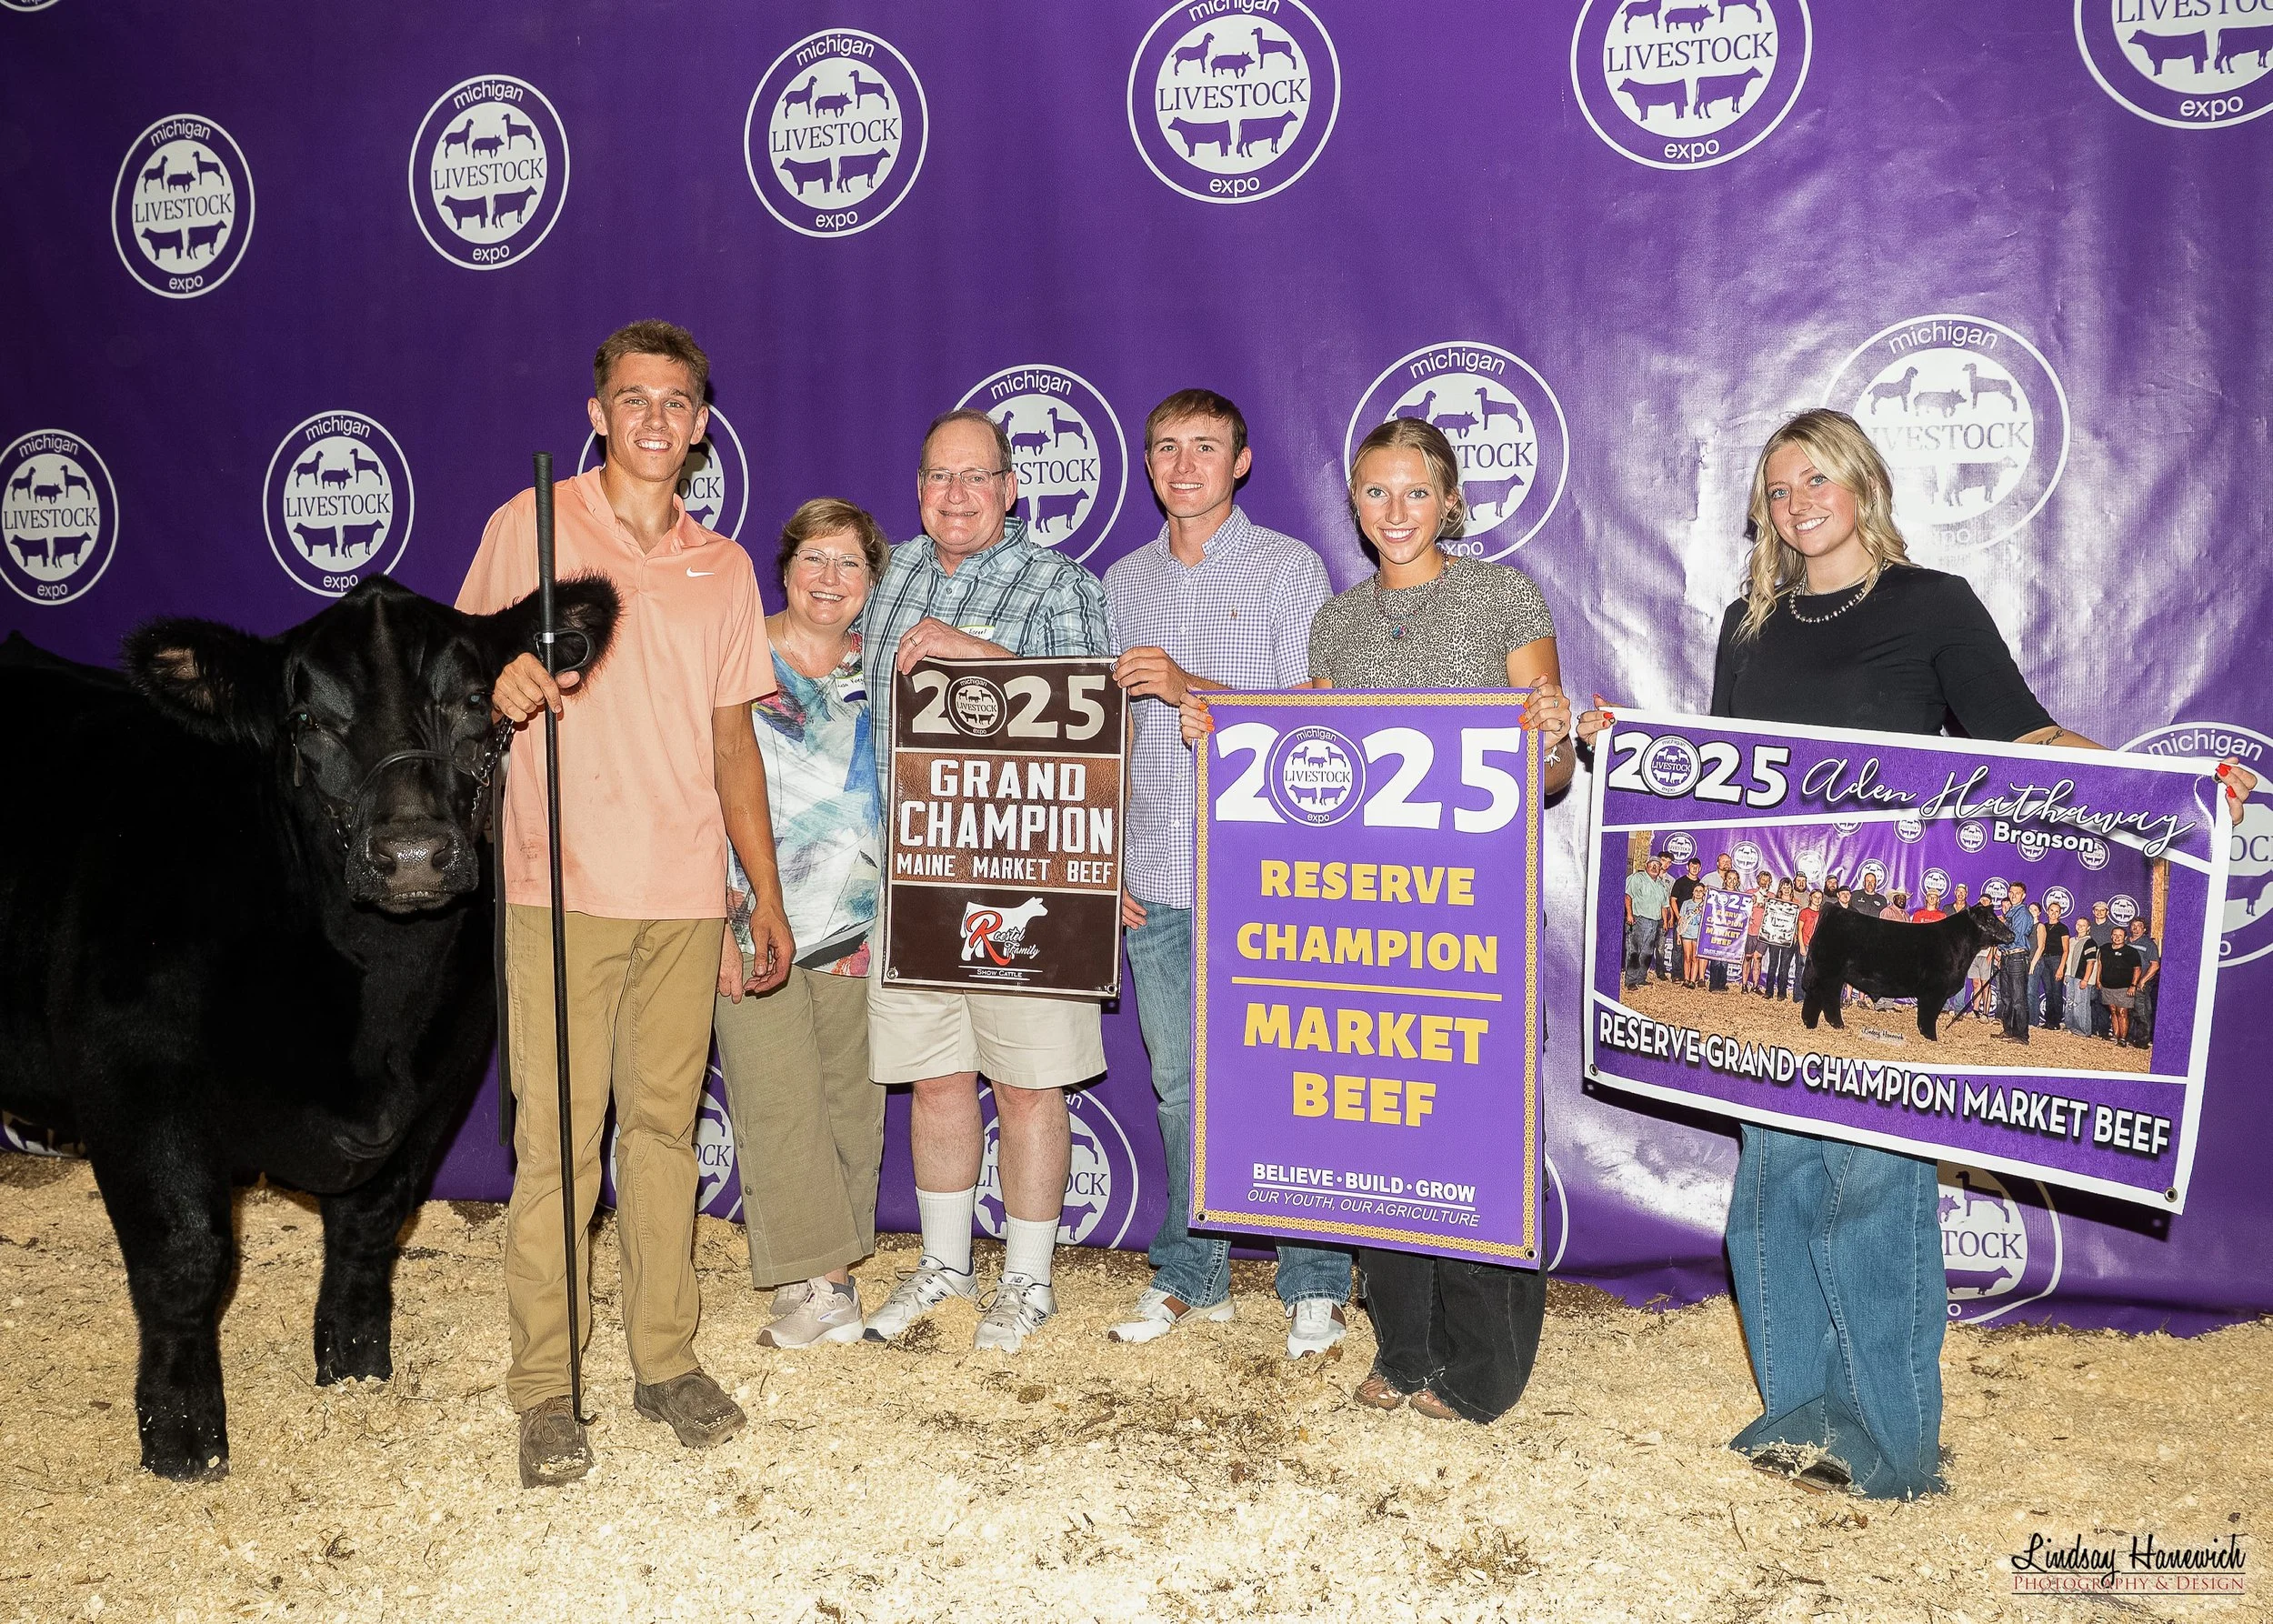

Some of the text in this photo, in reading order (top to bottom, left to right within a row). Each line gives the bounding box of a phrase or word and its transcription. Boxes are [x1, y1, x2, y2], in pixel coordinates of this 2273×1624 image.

[796, 35, 875, 66] michigan
[1607, 31, 1774, 73] LIVESTOCK
[454, 80, 524, 109] michigan
[1158, 77, 1307, 112] LIVESTOCK
[2180, 96, 2244, 122] expo
[151, 119, 211, 146] michigan
[772, 117, 899, 153] LIVESTOCK
[1664, 139, 1719, 163] expo
[434, 158, 544, 190] LIVESTOCK
[1209, 176, 1260, 196] expo
[135, 193, 233, 223] LIVESTOCK
[816, 211, 858, 231] expo
[473, 246, 510, 264] expo
[169, 275, 204, 292] expo
[1888, 321, 1998, 354] michigan
[1409, 348, 1506, 379] michigan
[991, 370, 1072, 400] michigan
[305, 416, 371, 441] michigan
[1870, 422, 2030, 452] IVESTOCK
[18, 435, 78, 457] michigan
[1012, 458, 1097, 486] STOCK
[4, 507, 98, 530] LIVESTOCK
[285, 493, 390, 517] LIVESTOCK
[37, 584, 68, 599] expo
[324, 575, 358, 591] expo
[960, 678, 987, 687] michigan
[956, 702, 997, 713] LIVESTOCK
[1297, 728, 1337, 742] michigan
[2148, 729, 2263, 761] michigan
[930, 758, 1086, 802] GRAND
[1286, 771, 1350, 783] LIVESTOCK
[1652, 761, 1691, 773] LIVESTOCK
[1307, 813, 1330, 824] expo
[1801, 757, 2197, 858] Aden Hathaway
[900, 800, 1113, 855] CHAMPION
[1994, 821, 2095, 852] Bronson
[896, 853, 1114, 884] MAINE MARKET BEEF
[1260, 860, 1475, 907] RESERVE
[1004, 940, 1040, 960] Family
[1237, 922, 1498, 975] CHAMPION
[1244, 1002, 1489, 1065] MARKET
[1599, 1012, 2171, 1155] RESERVE GRAND CHAMPION MARKET BEEF
[1292, 1071, 1437, 1128] BEEF
[1247, 1189, 1480, 1228] OUR YOUTH, OUR AGRICULTURE
